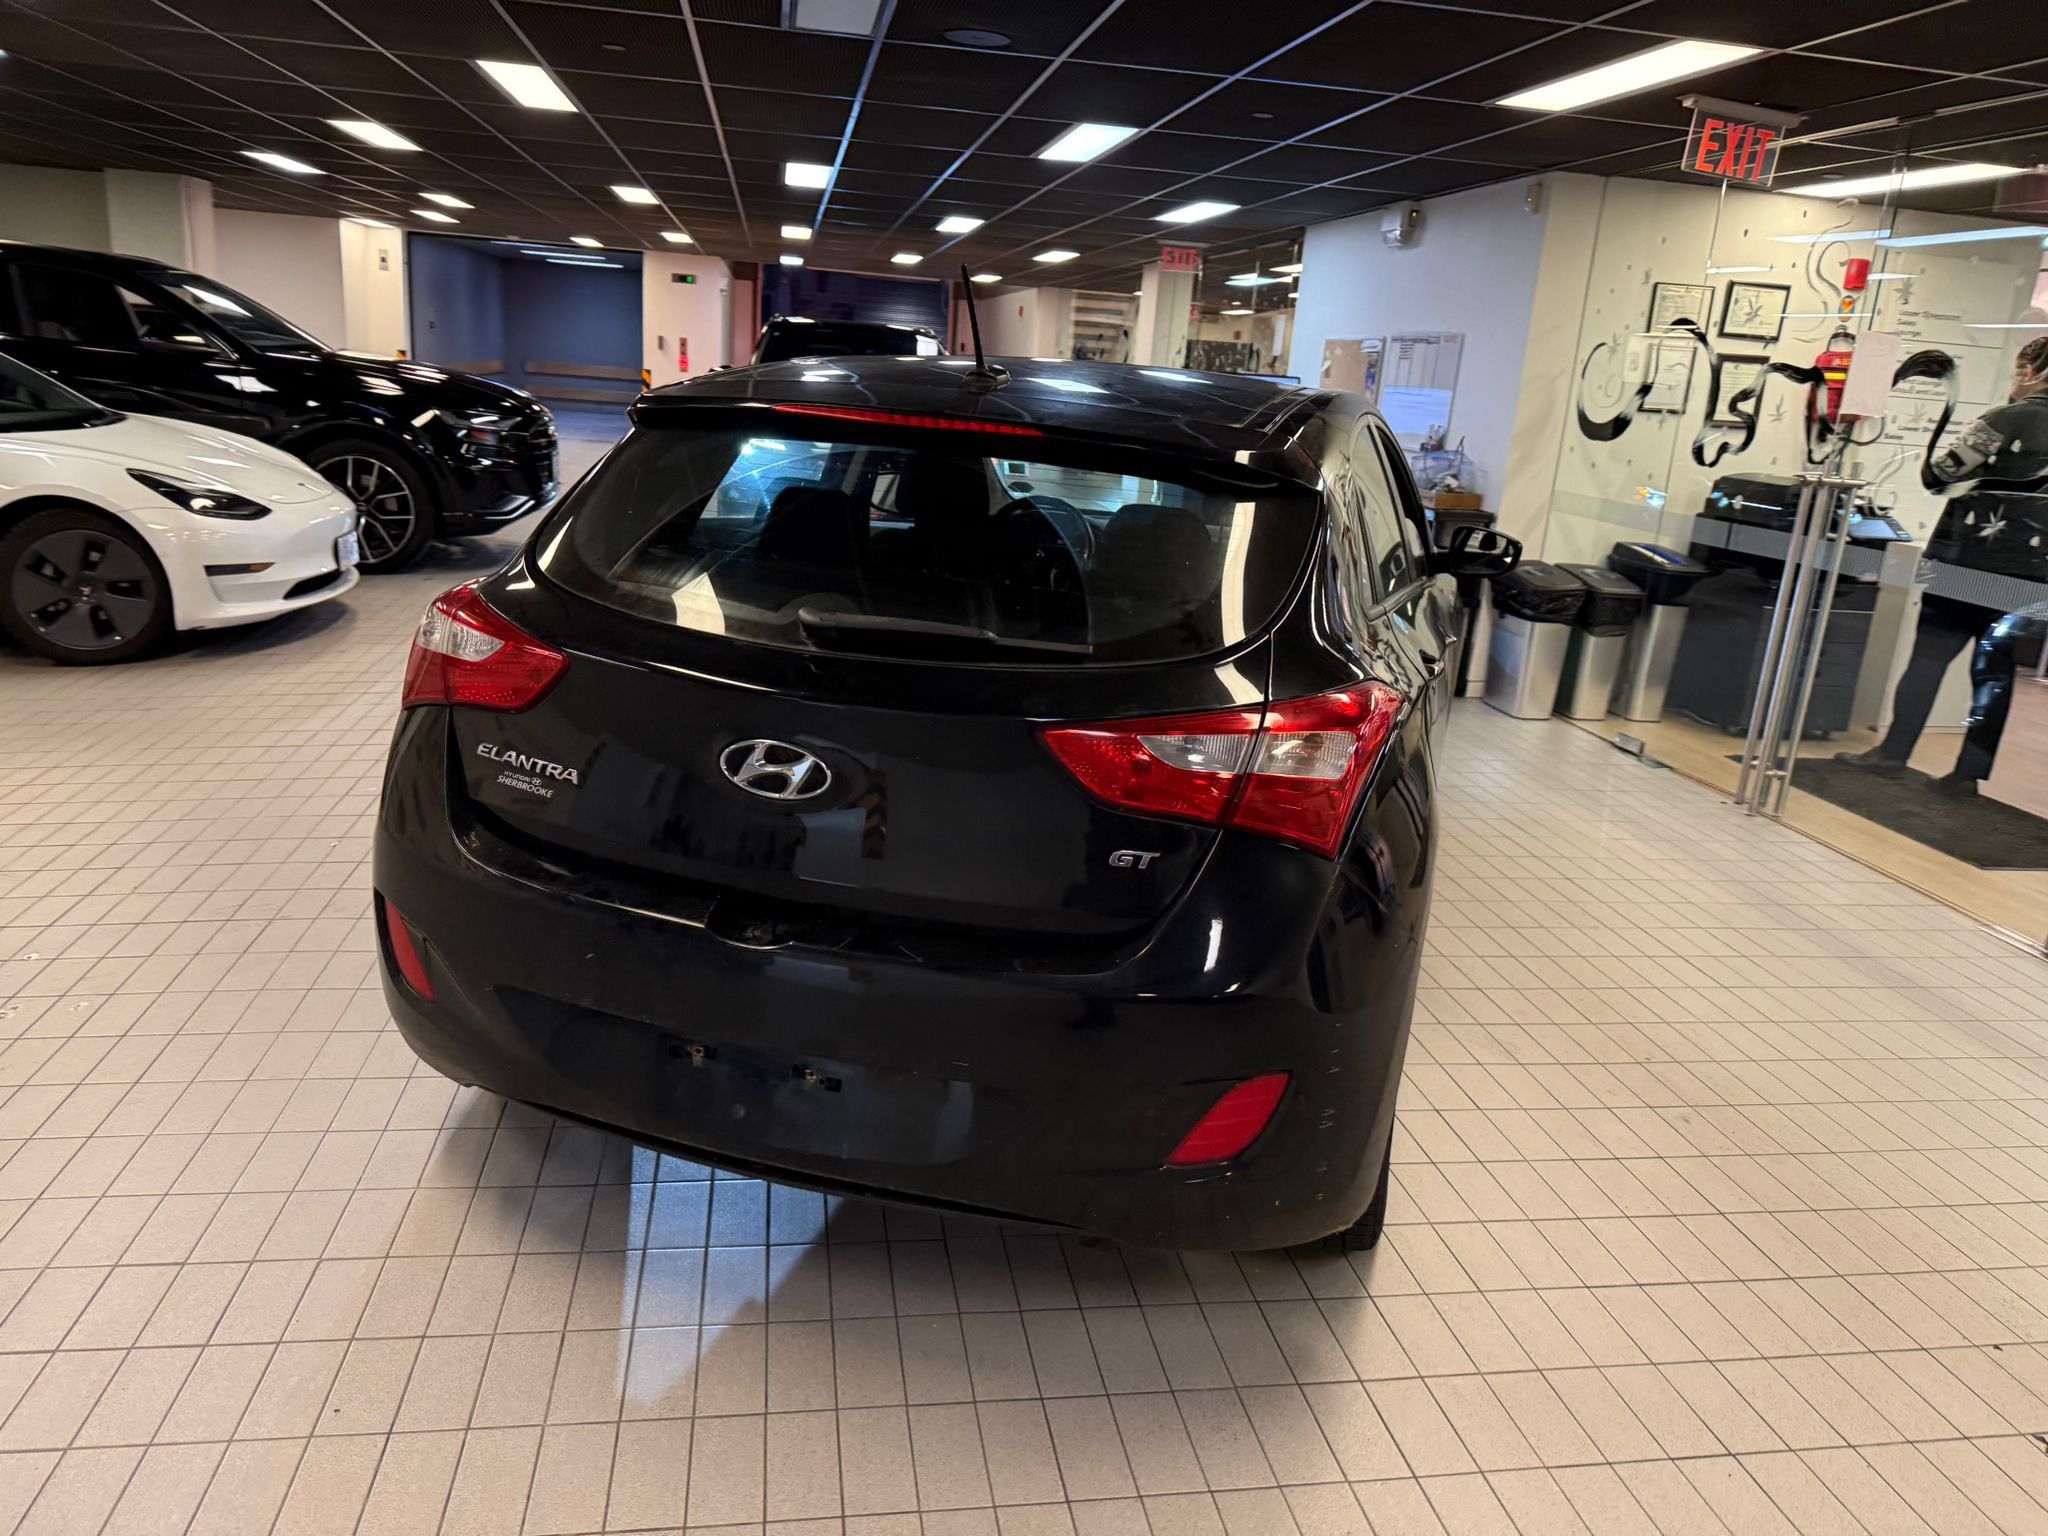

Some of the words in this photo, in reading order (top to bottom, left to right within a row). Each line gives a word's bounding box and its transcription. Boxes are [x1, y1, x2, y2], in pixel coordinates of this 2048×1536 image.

[1695, 118, 1775, 182] EXIT
[476, 742, 579, 785] ELANTRA
[496, 775, 554, 798] SHERBROOKE
[504, 770, 531, 783] HYUNDAI
[1108, 850, 1161, 869] GT
